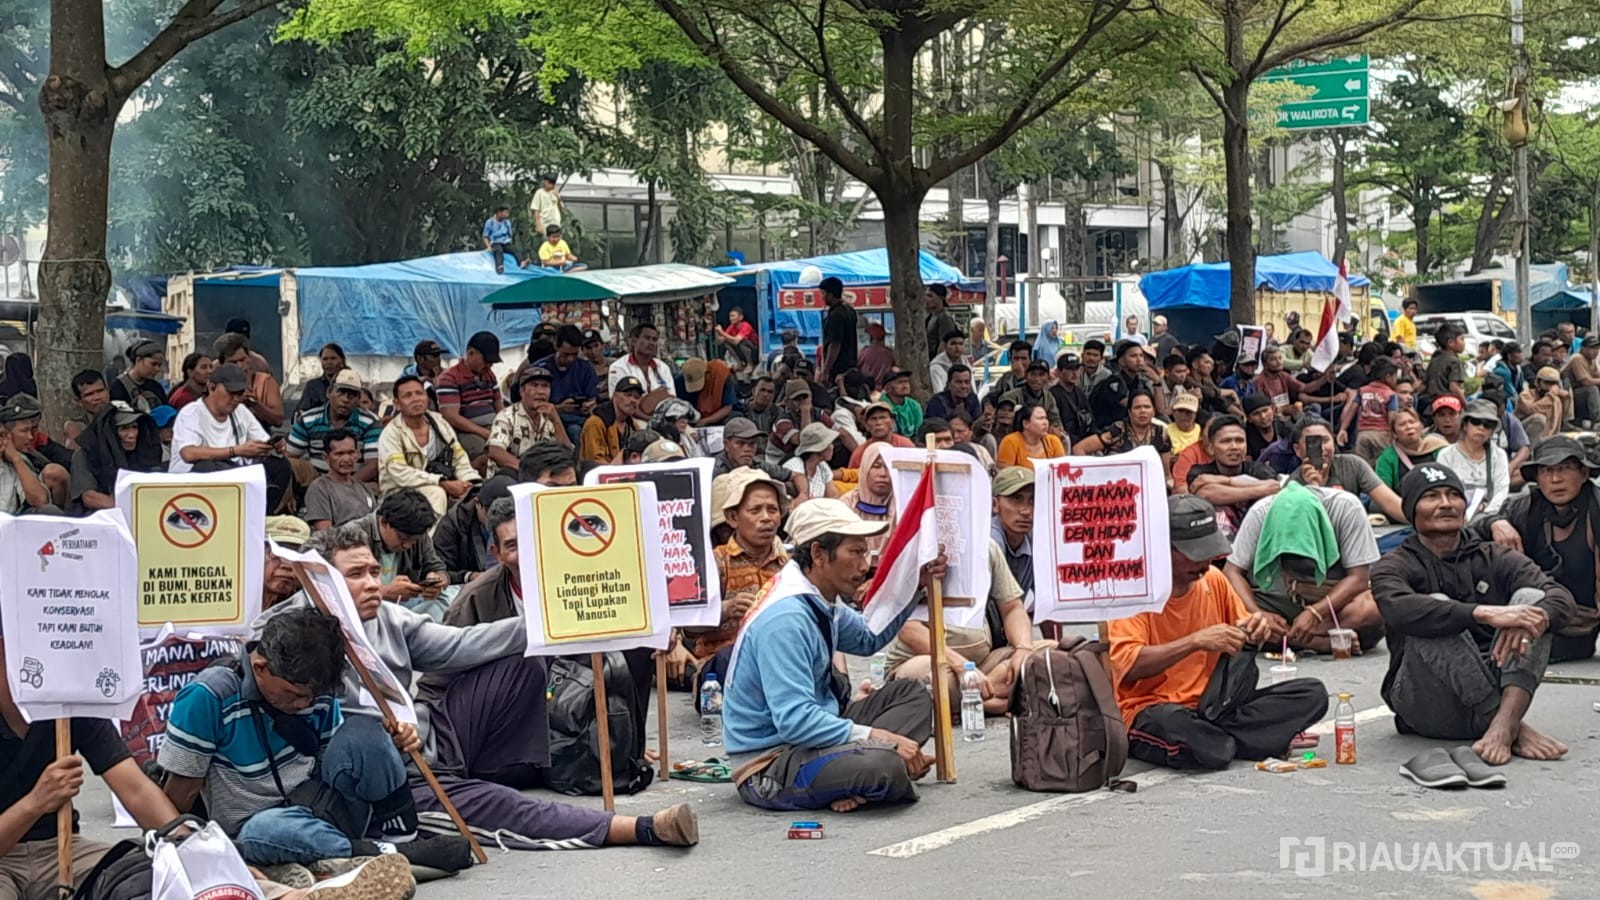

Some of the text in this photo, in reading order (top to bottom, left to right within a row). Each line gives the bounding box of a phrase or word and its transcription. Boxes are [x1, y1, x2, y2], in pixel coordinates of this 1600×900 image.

[1290, 108, 1339, 122] WALIKOTA
[1063, 486, 1133, 501] KAMI AKAN
[1063, 505, 1135, 523] BERTAHAN!
[1064, 524, 1136, 541] DEMI HIDUP
[1084, 545, 1114, 560] DAN
[149, 566, 227, 579] KAMI TINGGAL
[564, 569, 621, 584] Pemerintah
[1060, 564, 1105, 579] TANAH
[143, 578, 232, 593] DI BUMI, BUKAN
[557, 583, 631, 598] Lindungi Hutan
[27, 588, 110, 600] KAMI TIDAK MENOLAK
[144, 591, 232, 605] DI ATAS KERTAS
[562, 595, 627, 612] Tapi Lupakan
[576, 609, 617, 621] Manusia
[37, 622, 103, 633] TAPI KAMI BUTUH
[50, 640, 93, 650] KEADILAN!
[146, 643, 194, 666] MANA
